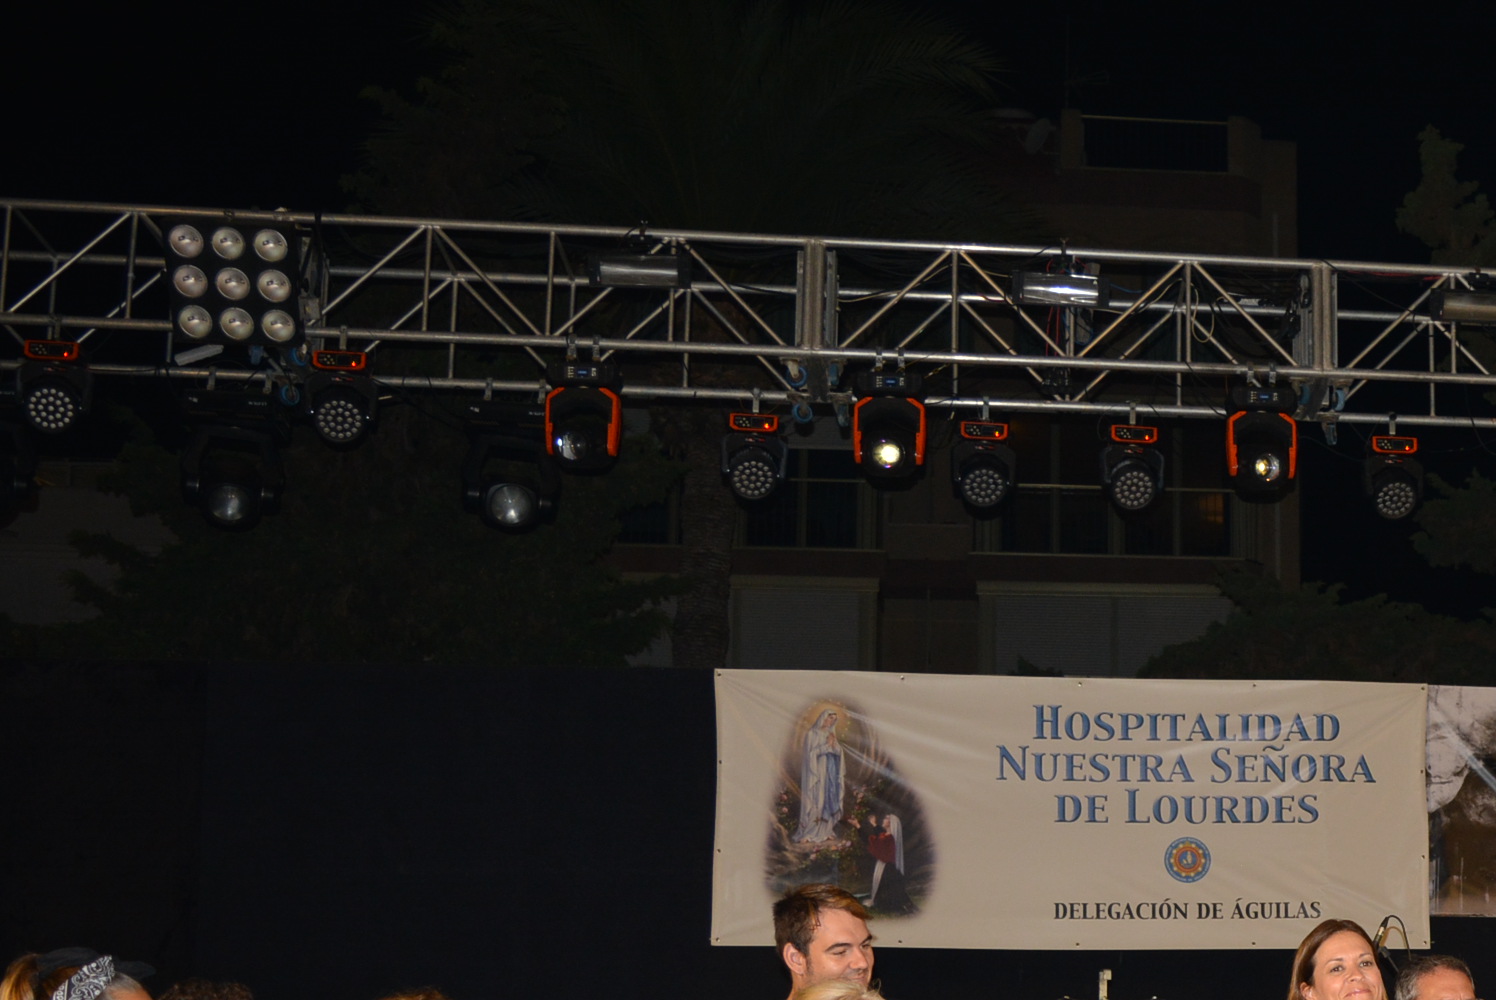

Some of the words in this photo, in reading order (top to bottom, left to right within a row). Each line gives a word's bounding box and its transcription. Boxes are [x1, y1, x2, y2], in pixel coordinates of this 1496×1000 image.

[1032, 704, 1340, 742] HOSPITALIDAD
[996, 744, 1195, 783] NUESTRA
[1210, 744, 1377, 784] SEÑORA
[1054, 794, 1109, 824] DE
[1124, 788, 1319, 825] LOURDES
[1053, 898, 1189, 920] DELEGACIÓN
[1196, 902, 1224, 920] DE
[1230, 898, 1321, 920] ÁGUILAS
